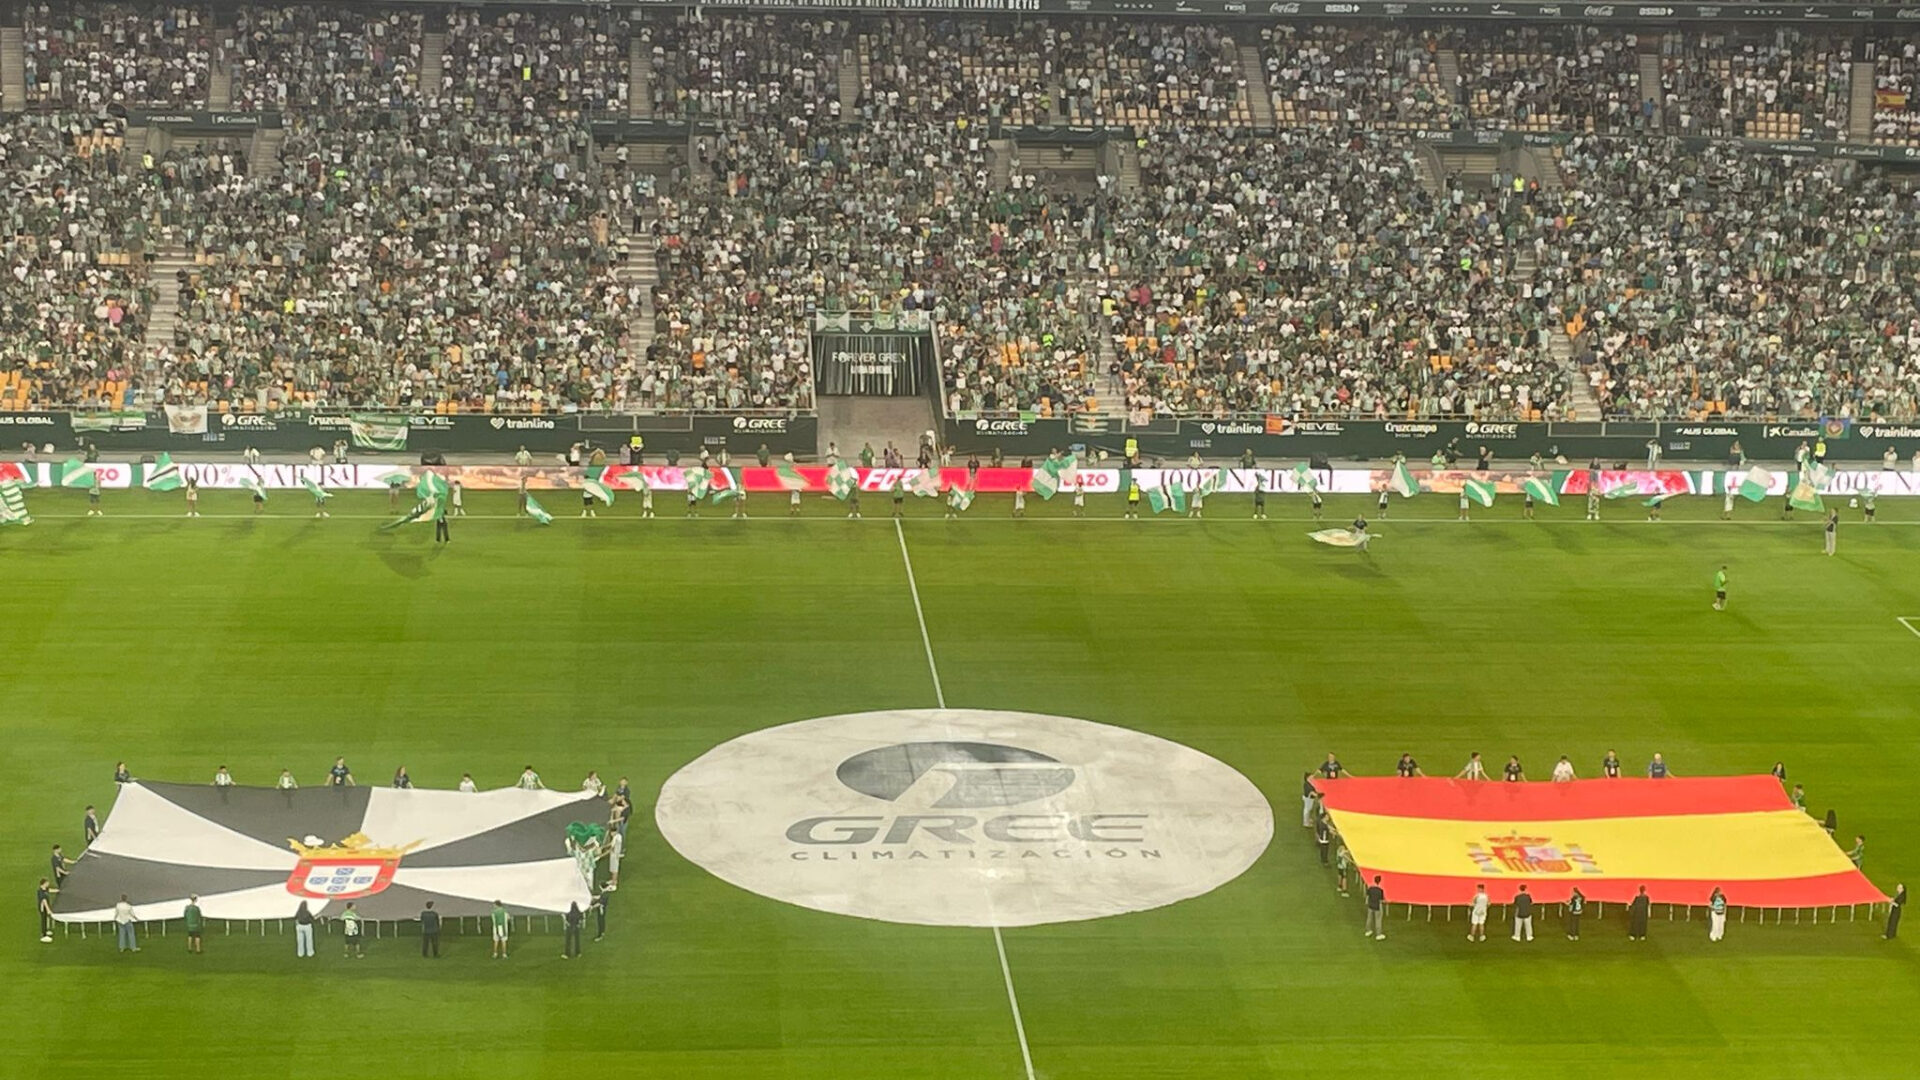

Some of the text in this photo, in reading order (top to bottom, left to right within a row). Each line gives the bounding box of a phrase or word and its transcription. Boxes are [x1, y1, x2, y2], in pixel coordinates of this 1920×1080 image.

[15, 416, 54, 425] GLOBAL
[506, 417, 555, 429] trainline
[748, 418, 787, 429] GREE
[1217, 421, 1263, 434] trainline
[1384, 422, 1438, 434] Cruzcampo
[1480, 424, 1518, 434] GREE
[1682, 427, 1739, 436] AUS GLOBAL
[785, 813, 1150, 845] GREE
[791, 846, 1163, 861] CLIMATIZACIÓN
